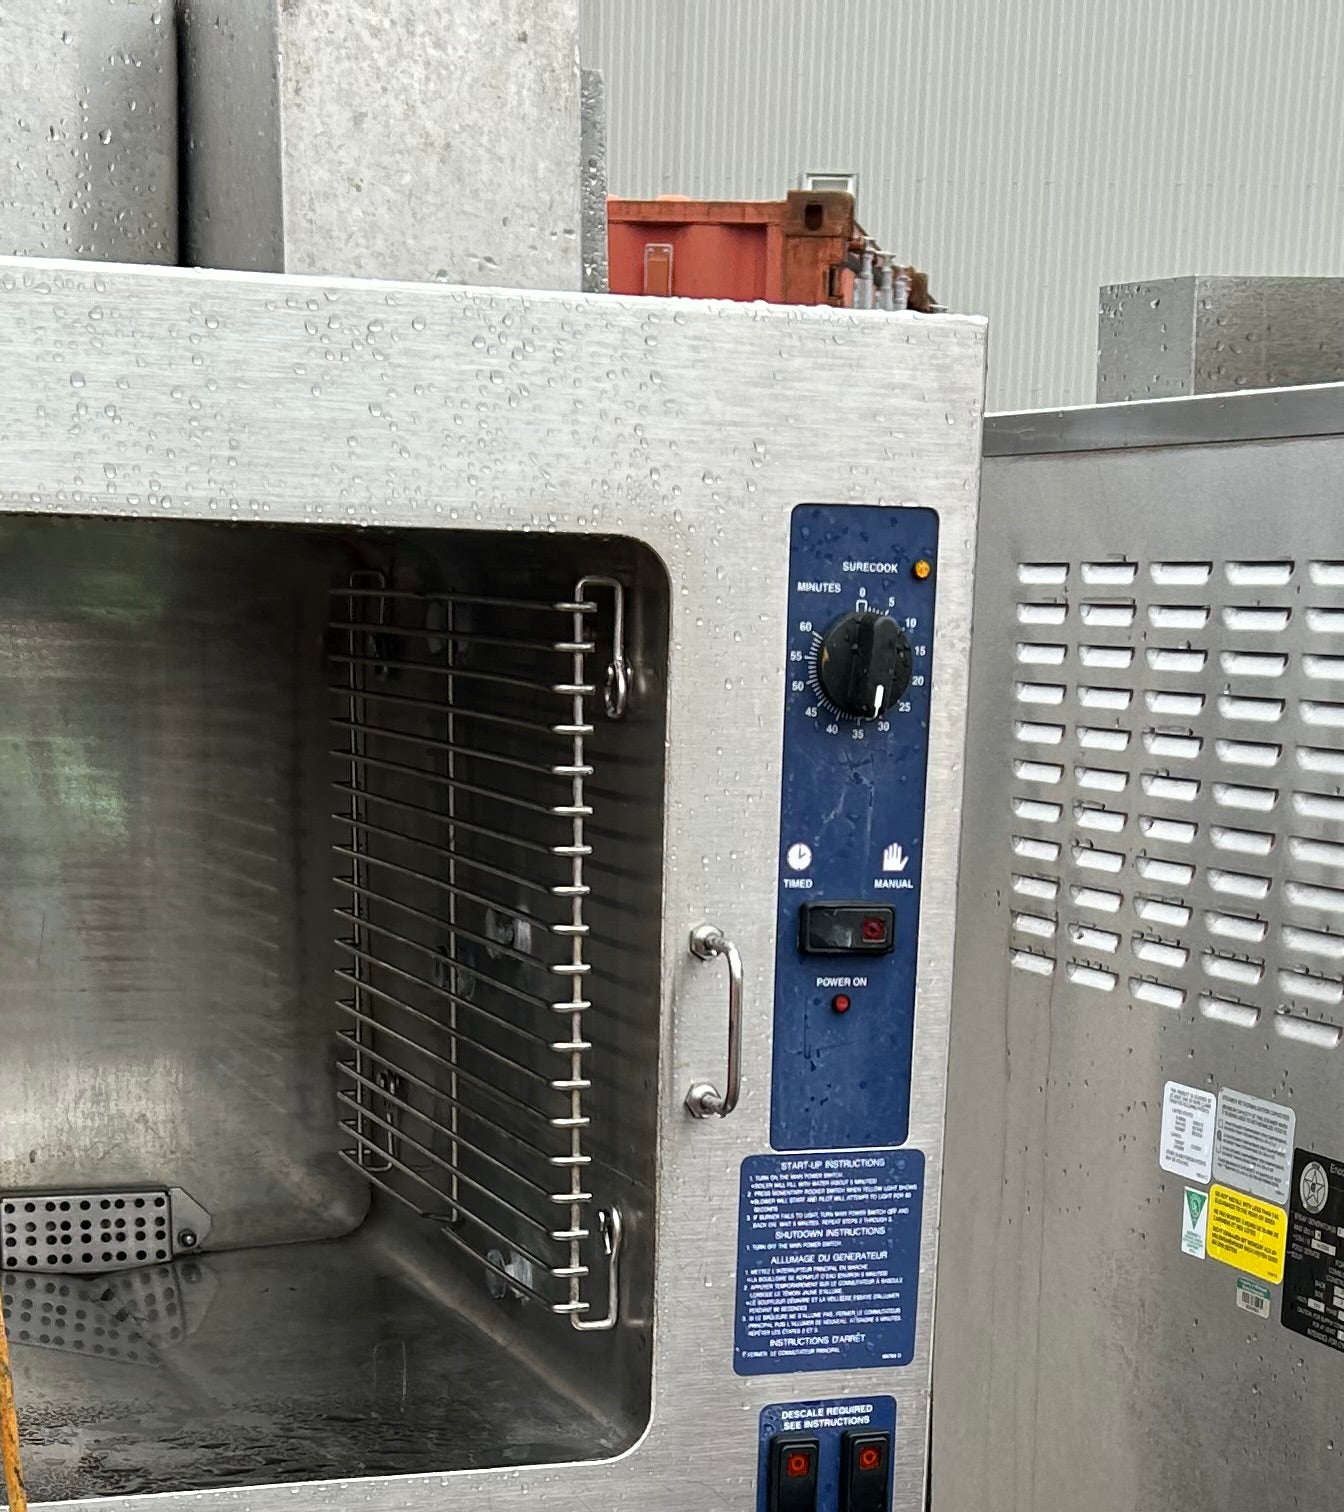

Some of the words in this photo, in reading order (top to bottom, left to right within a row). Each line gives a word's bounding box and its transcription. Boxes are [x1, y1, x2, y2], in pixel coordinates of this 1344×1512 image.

[842, 561, 899, 574] SURECOOK
[796, 582, 842, 594] MINUTES
[858, 587, 866, 598] 0
[888, 597, 896, 608] 5
[799, 622, 813, 633] 60
[905, 618, 917, 628] 10
[914, 645, 926, 656] 15
[790, 651, 803, 662] 55
[792, 680, 804, 692] 50
[912, 675, 924, 687] 20
[805, 706, 818, 718] 45
[898, 702, 912, 713] 25
[826, 724, 838, 735] 40
[878, 720, 890, 732] 30
[852, 728, 864, 740] 35
[783, 878, 813, 889] TIMED
[874, 879, 914, 889] MANUAL
[816, 978, 851, 987] POWER
[852, 977, 868, 987] ON
[825, 1158, 886, 1168] INSTRUCTIONS
[774, 1230, 824, 1240] SHUTDOWN
[826, 1226, 886, 1237] INSTRUCTIONS
[770, 1254, 815, 1264] ALLUMAGE
[818, 1254, 831, 1262] DU
[770, 1336, 830, 1346] INSTRUCTIONS
[782, 1408, 824, 1420] DESCALE
[826, 1404, 874, 1416] REQUIRED
[783, 1421, 802, 1430] SEE
[804, 1415, 870, 1429] INSTRUCTIONS
